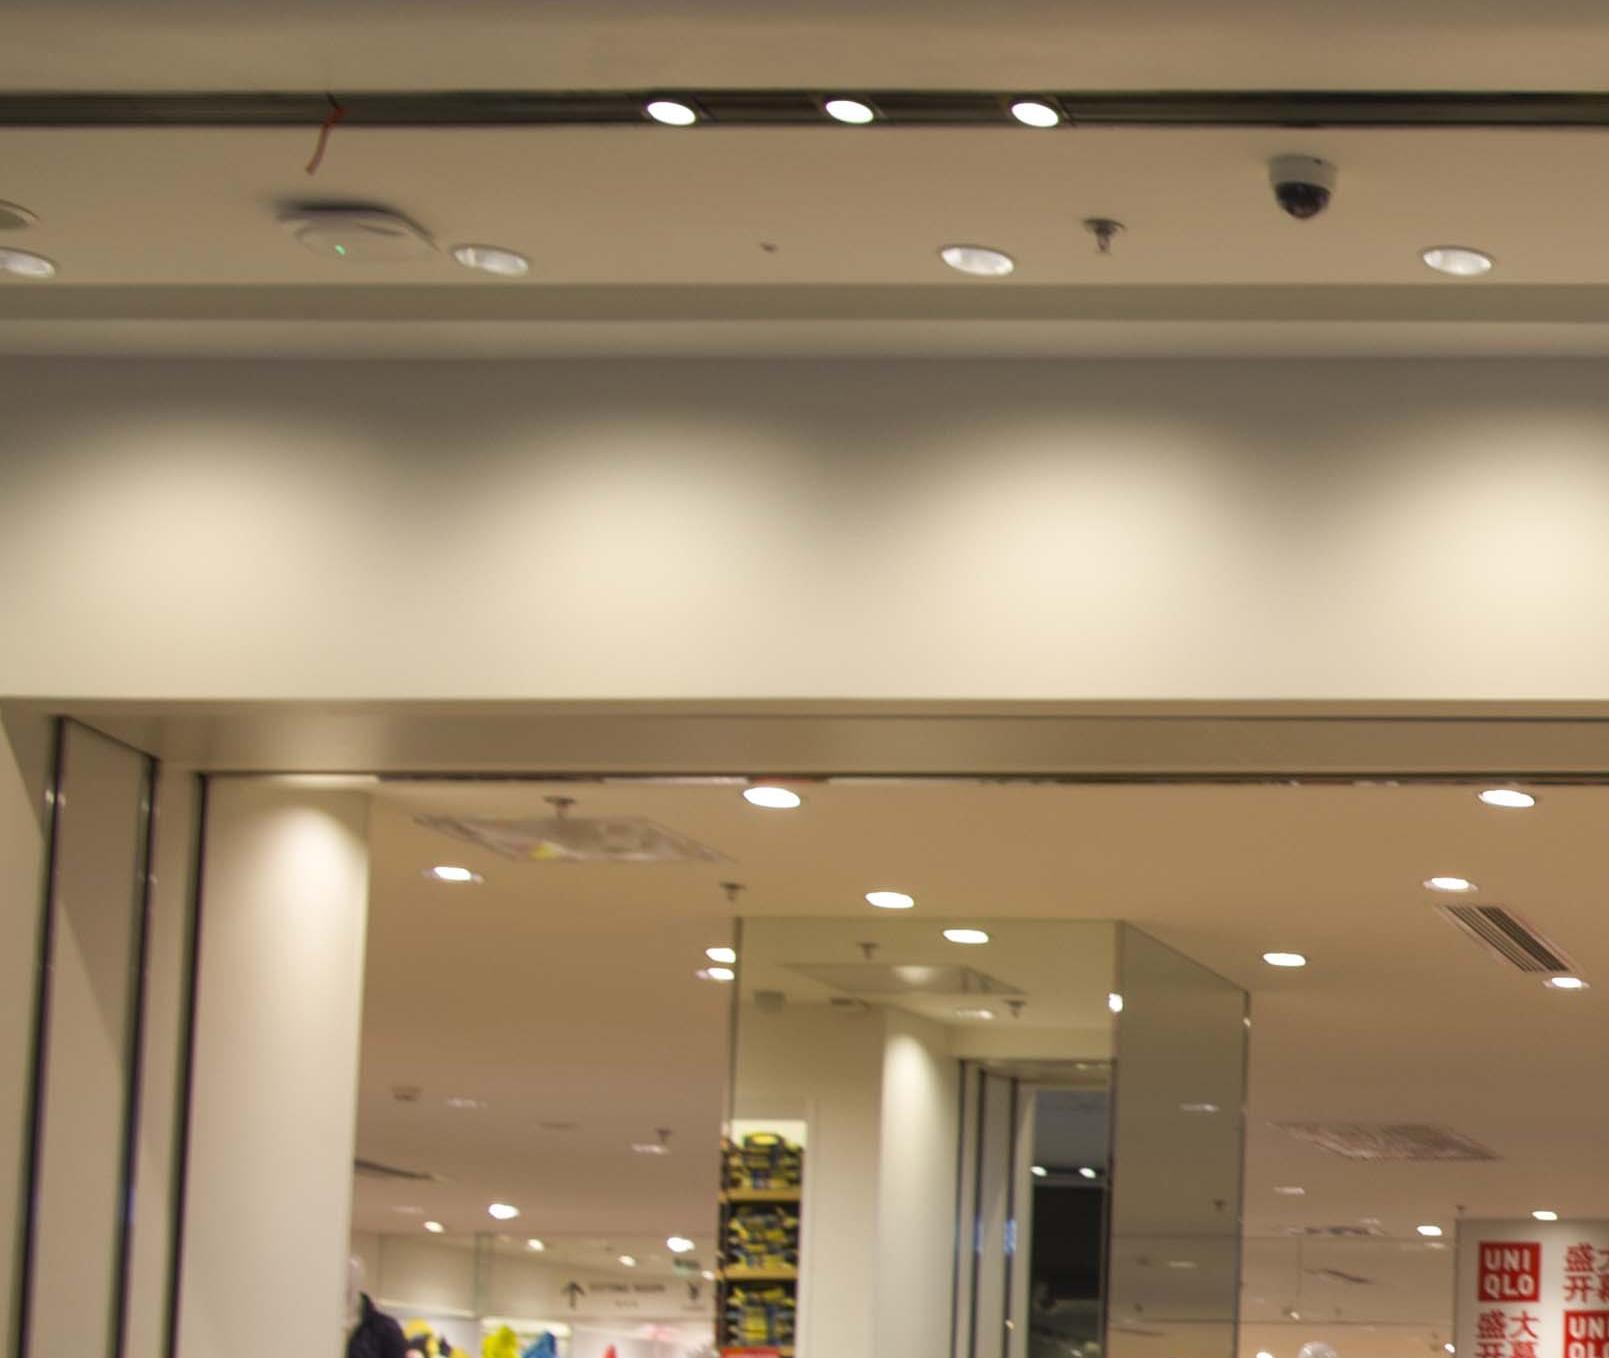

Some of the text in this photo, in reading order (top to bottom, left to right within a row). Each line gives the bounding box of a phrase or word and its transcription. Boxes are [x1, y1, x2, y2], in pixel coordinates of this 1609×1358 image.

[1484, 1249, 1532, 1271] UNI
[1484, 1274, 1535, 1299] QLO
[1475, 1309, 1539, 1339] 盛大
